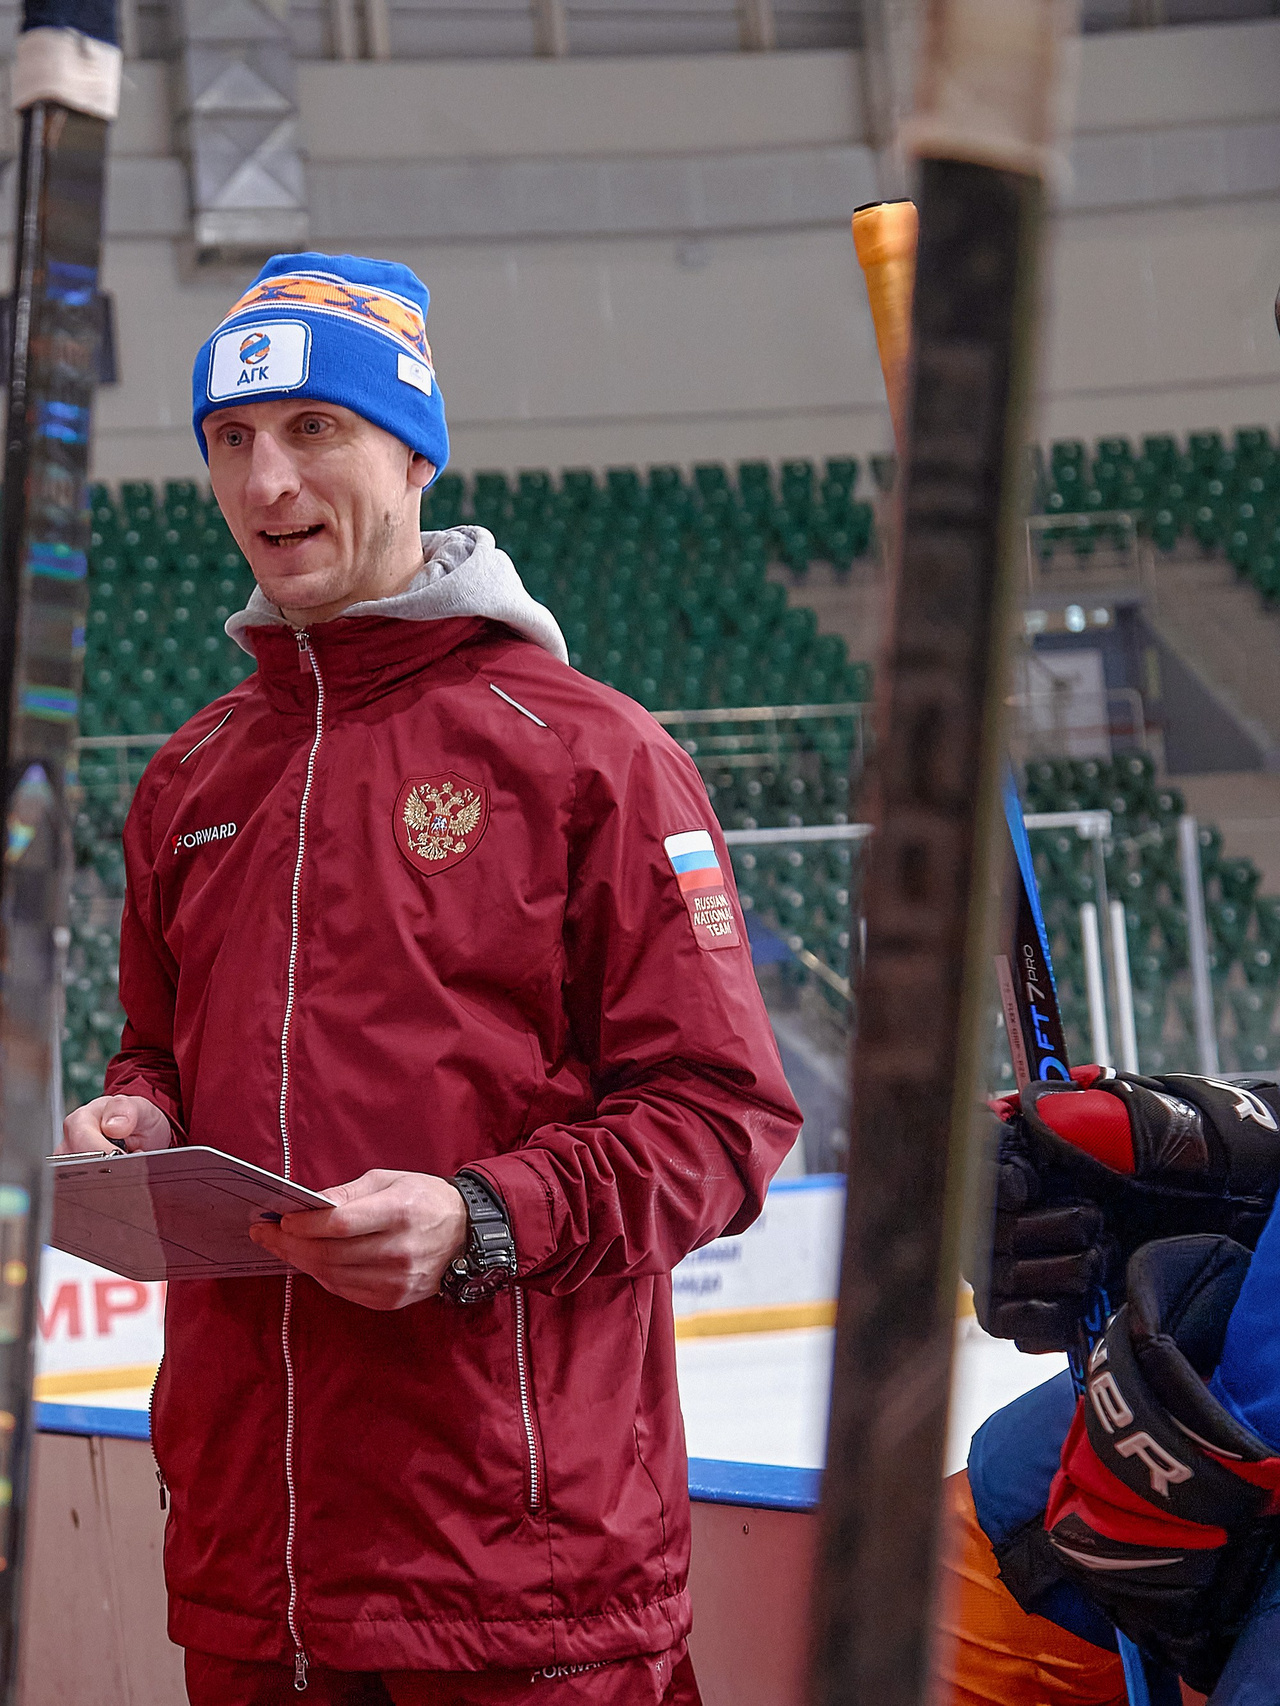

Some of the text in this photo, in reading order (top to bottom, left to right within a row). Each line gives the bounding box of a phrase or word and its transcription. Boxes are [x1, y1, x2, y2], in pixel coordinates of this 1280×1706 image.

[237, 366, 269, 386] ДГК
[171, 822, 237, 855] FORWARD
[694, 894, 729, 911] RUSSIAN
[693, 907, 734, 926] NATIONAL
[706, 922, 732, 937] TEAM
